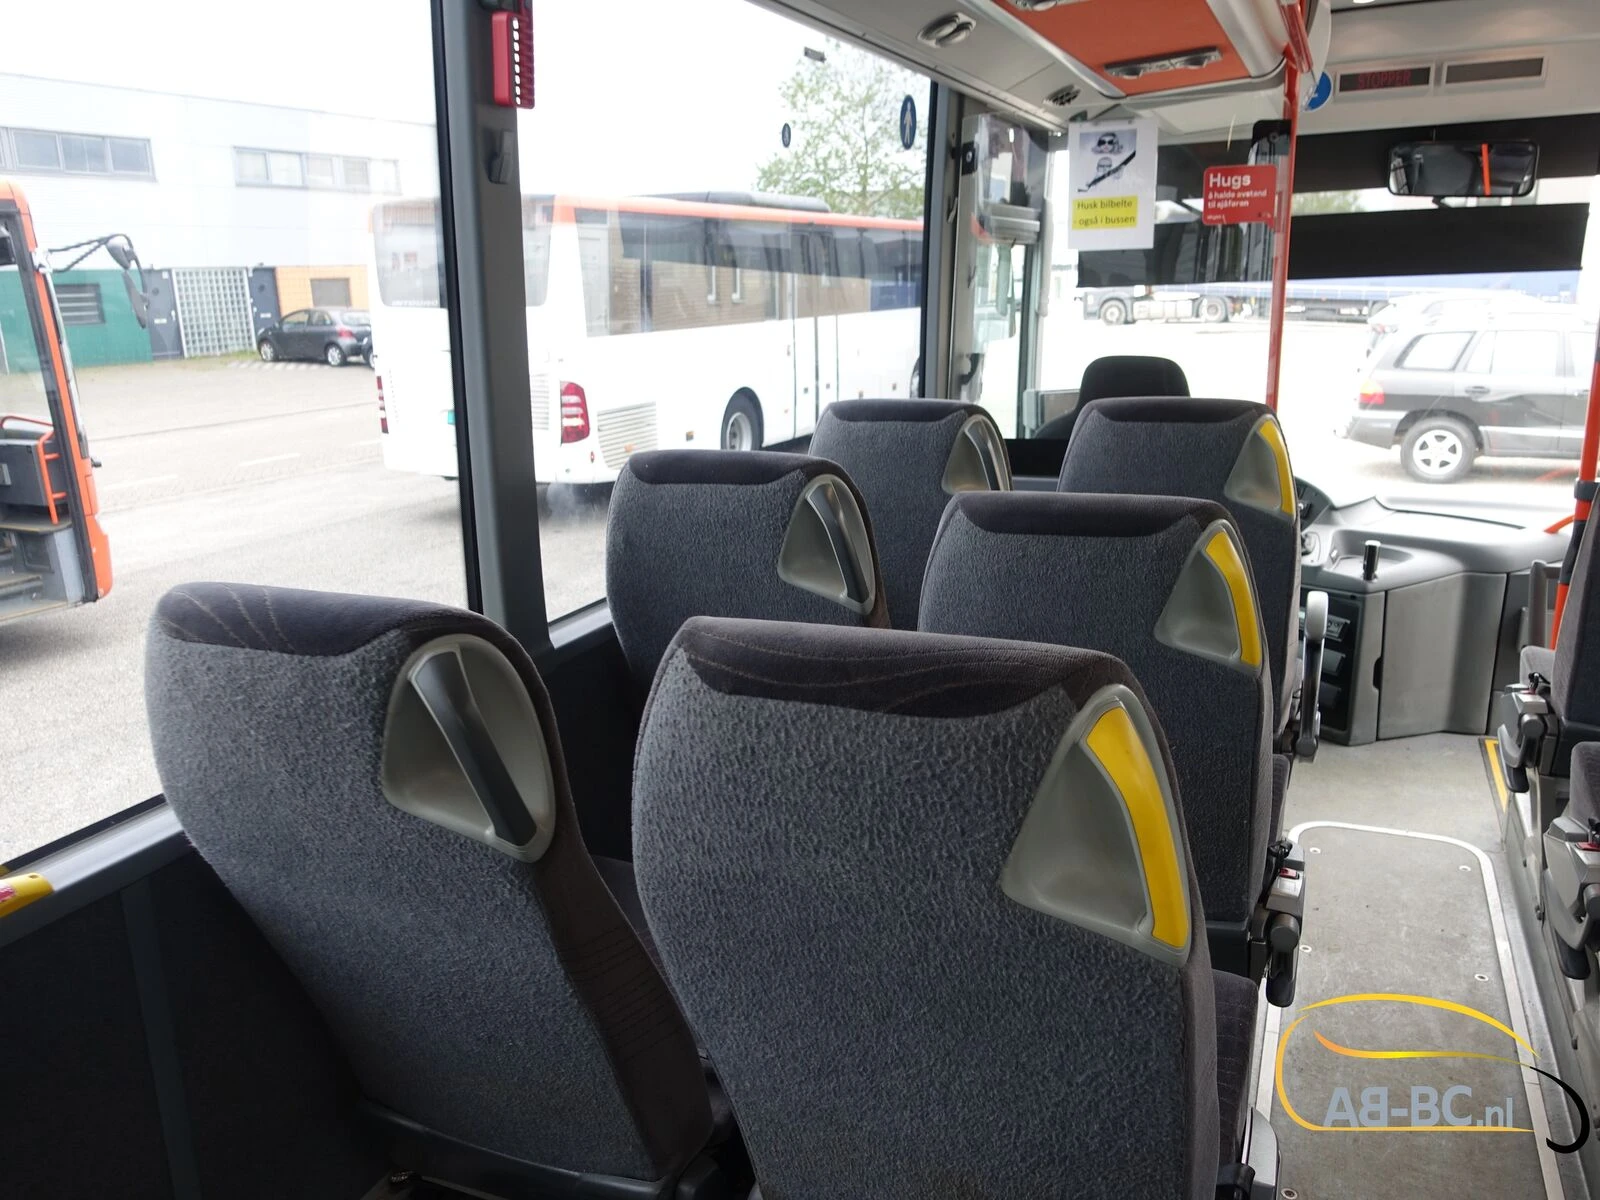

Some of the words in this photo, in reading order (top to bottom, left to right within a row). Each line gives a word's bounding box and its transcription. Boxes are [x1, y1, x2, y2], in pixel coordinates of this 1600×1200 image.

[1357, 71, 1412, 89] STOPPER
[1209, 172, 1252, 190] Hugs
[1214, 190, 1236, 199] halde
[1236, 188, 1268, 198] avstand
[1077, 199, 1098, 209] Husk
[1100, 199, 1133, 209] bilbelte
[1207, 201, 1216, 209] til
[1078, 215, 1099, 227] også
[1105, 215, 1136, 225] bussen
